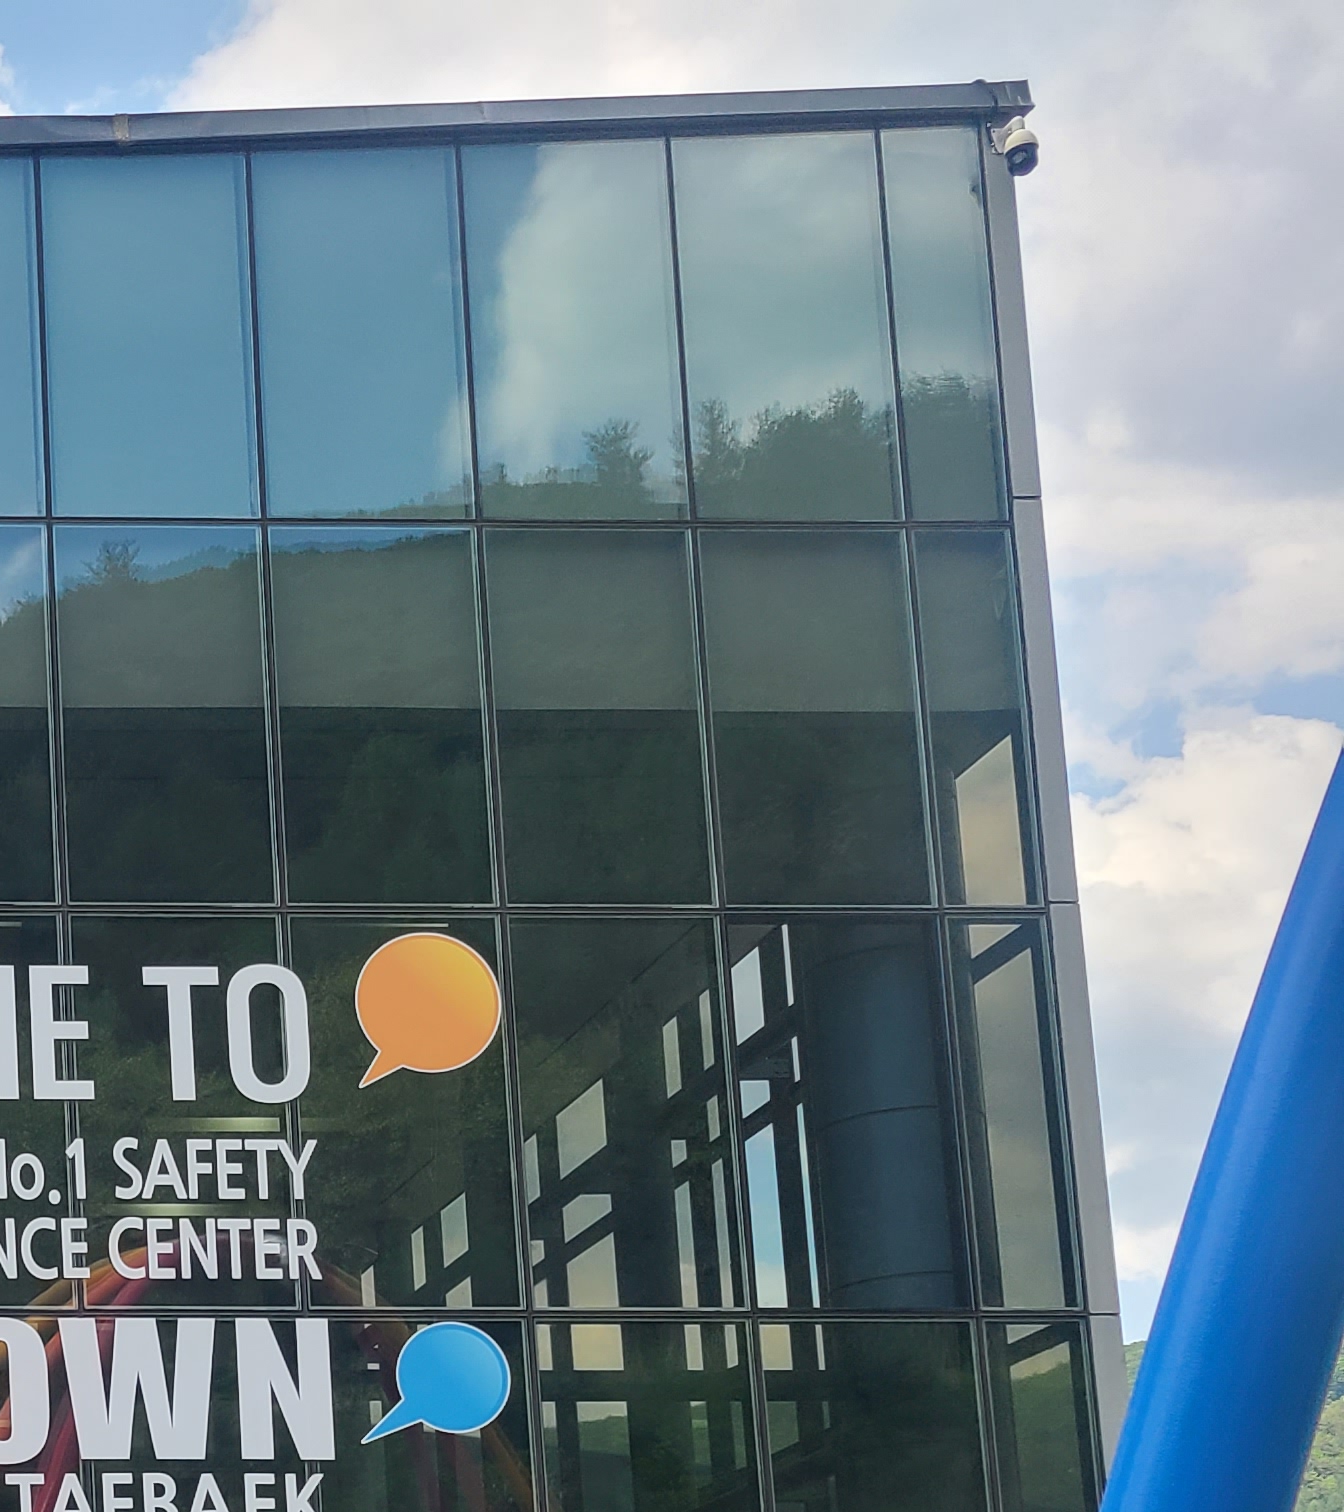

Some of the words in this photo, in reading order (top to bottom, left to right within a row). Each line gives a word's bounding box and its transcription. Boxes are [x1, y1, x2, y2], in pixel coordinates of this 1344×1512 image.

[141, 962, 311, 1104] TO
[113, 1137, 317, 1200] SAFETY
[108, 1216, 323, 1281] CENTER
